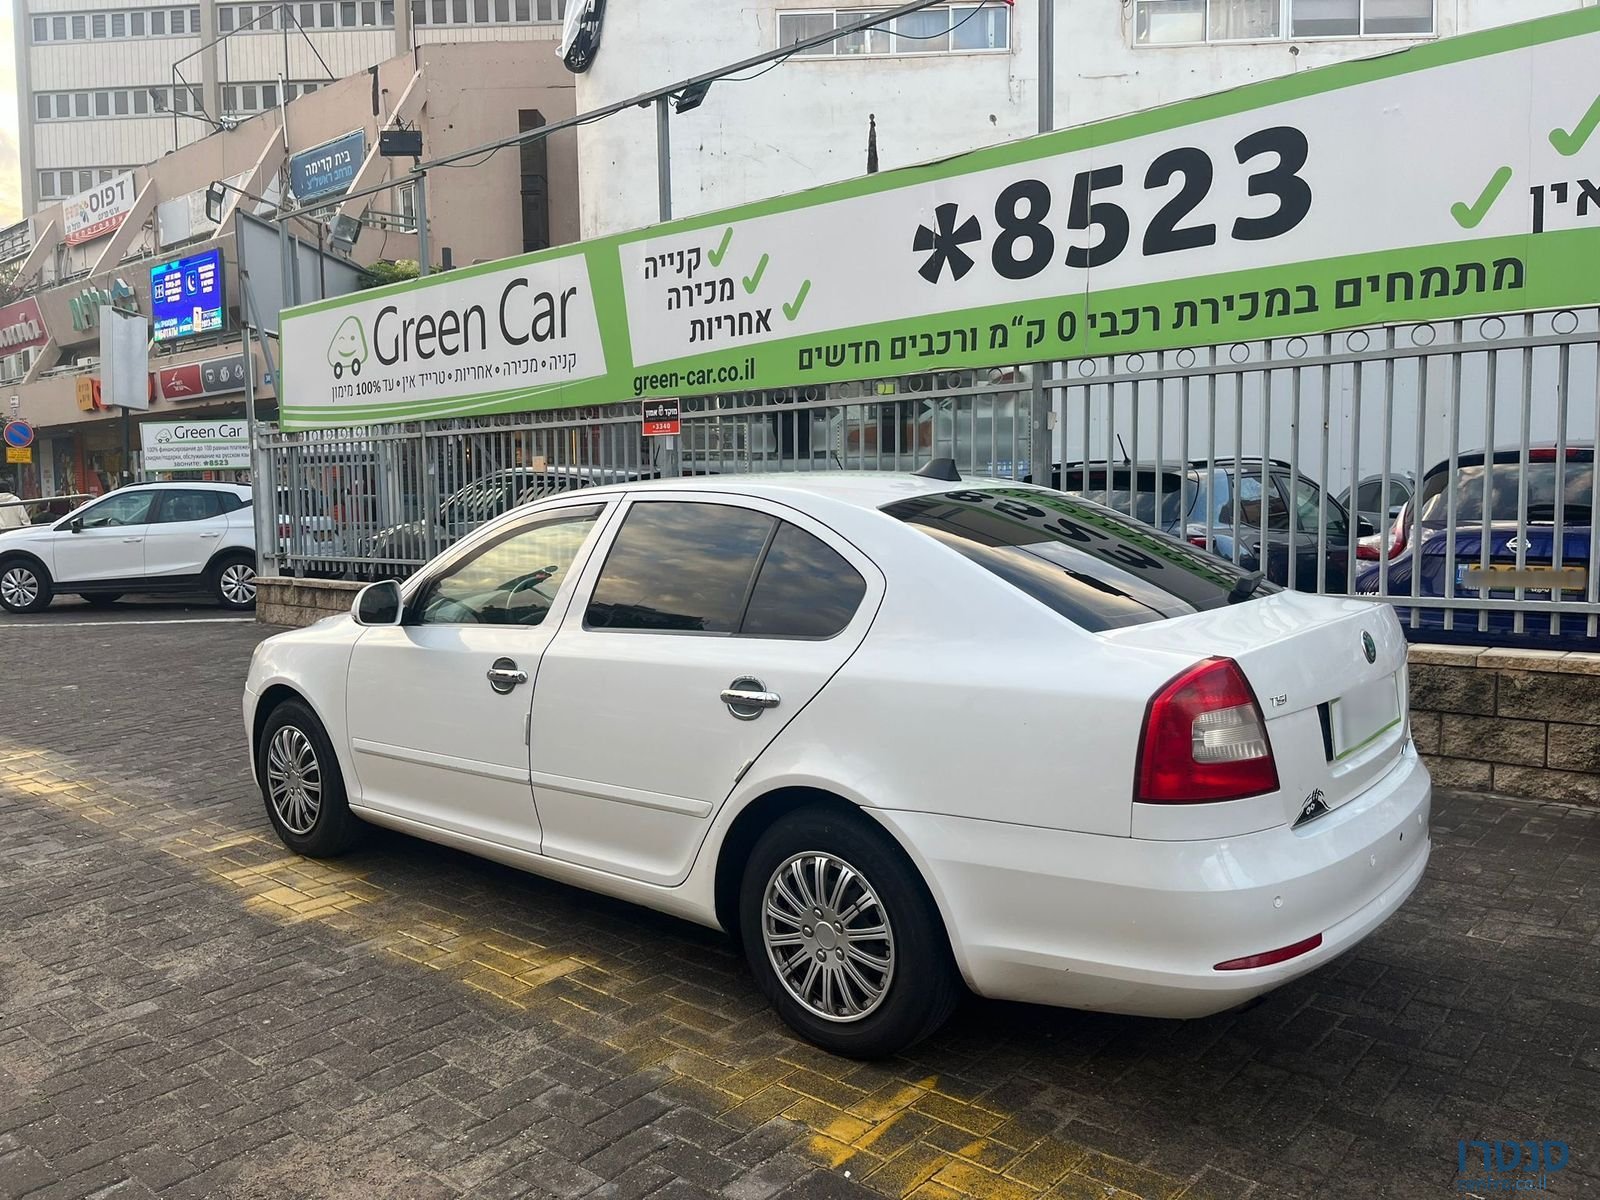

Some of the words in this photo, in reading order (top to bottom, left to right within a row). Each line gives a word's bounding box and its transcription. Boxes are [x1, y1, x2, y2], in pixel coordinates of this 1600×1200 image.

[305, 156, 332, 177] קדימה
[334, 150, 351, 166] בית
[89, 180, 125, 213] דפוס
[645, 247, 701, 279] קנייה
[667, 277, 735, 310] מכירה
[1335, 257, 1524, 309] מתמחים
[373, 305, 487, 366] Green
[499, 277, 577, 346] Car
[1172, 284, 1318, 329] במכירת
[689, 308, 772, 343] אחריות
[1057, 310, 1077, 342] 0
[1087, 305, 1160, 339] רכבי
[799, 340, 880, 370] חדשים
[890, 327, 978, 360] ורכבים
[454, 363, 493, 383] אחריות
[503, 357, 538, 377] מכירה
[549, 352, 577, 373] קניה
[633, 357, 755, 396] green-car.co.il
[331, 384, 353, 403] מימון
[356, 380, 381, 396] 100%
[382, 377, 394, 392] עד
[402, 374, 416, 393] אין
[418, 370, 446, 387] טרייד
[174, 425, 216, 439] Green
[219, 424, 242, 438] Car
